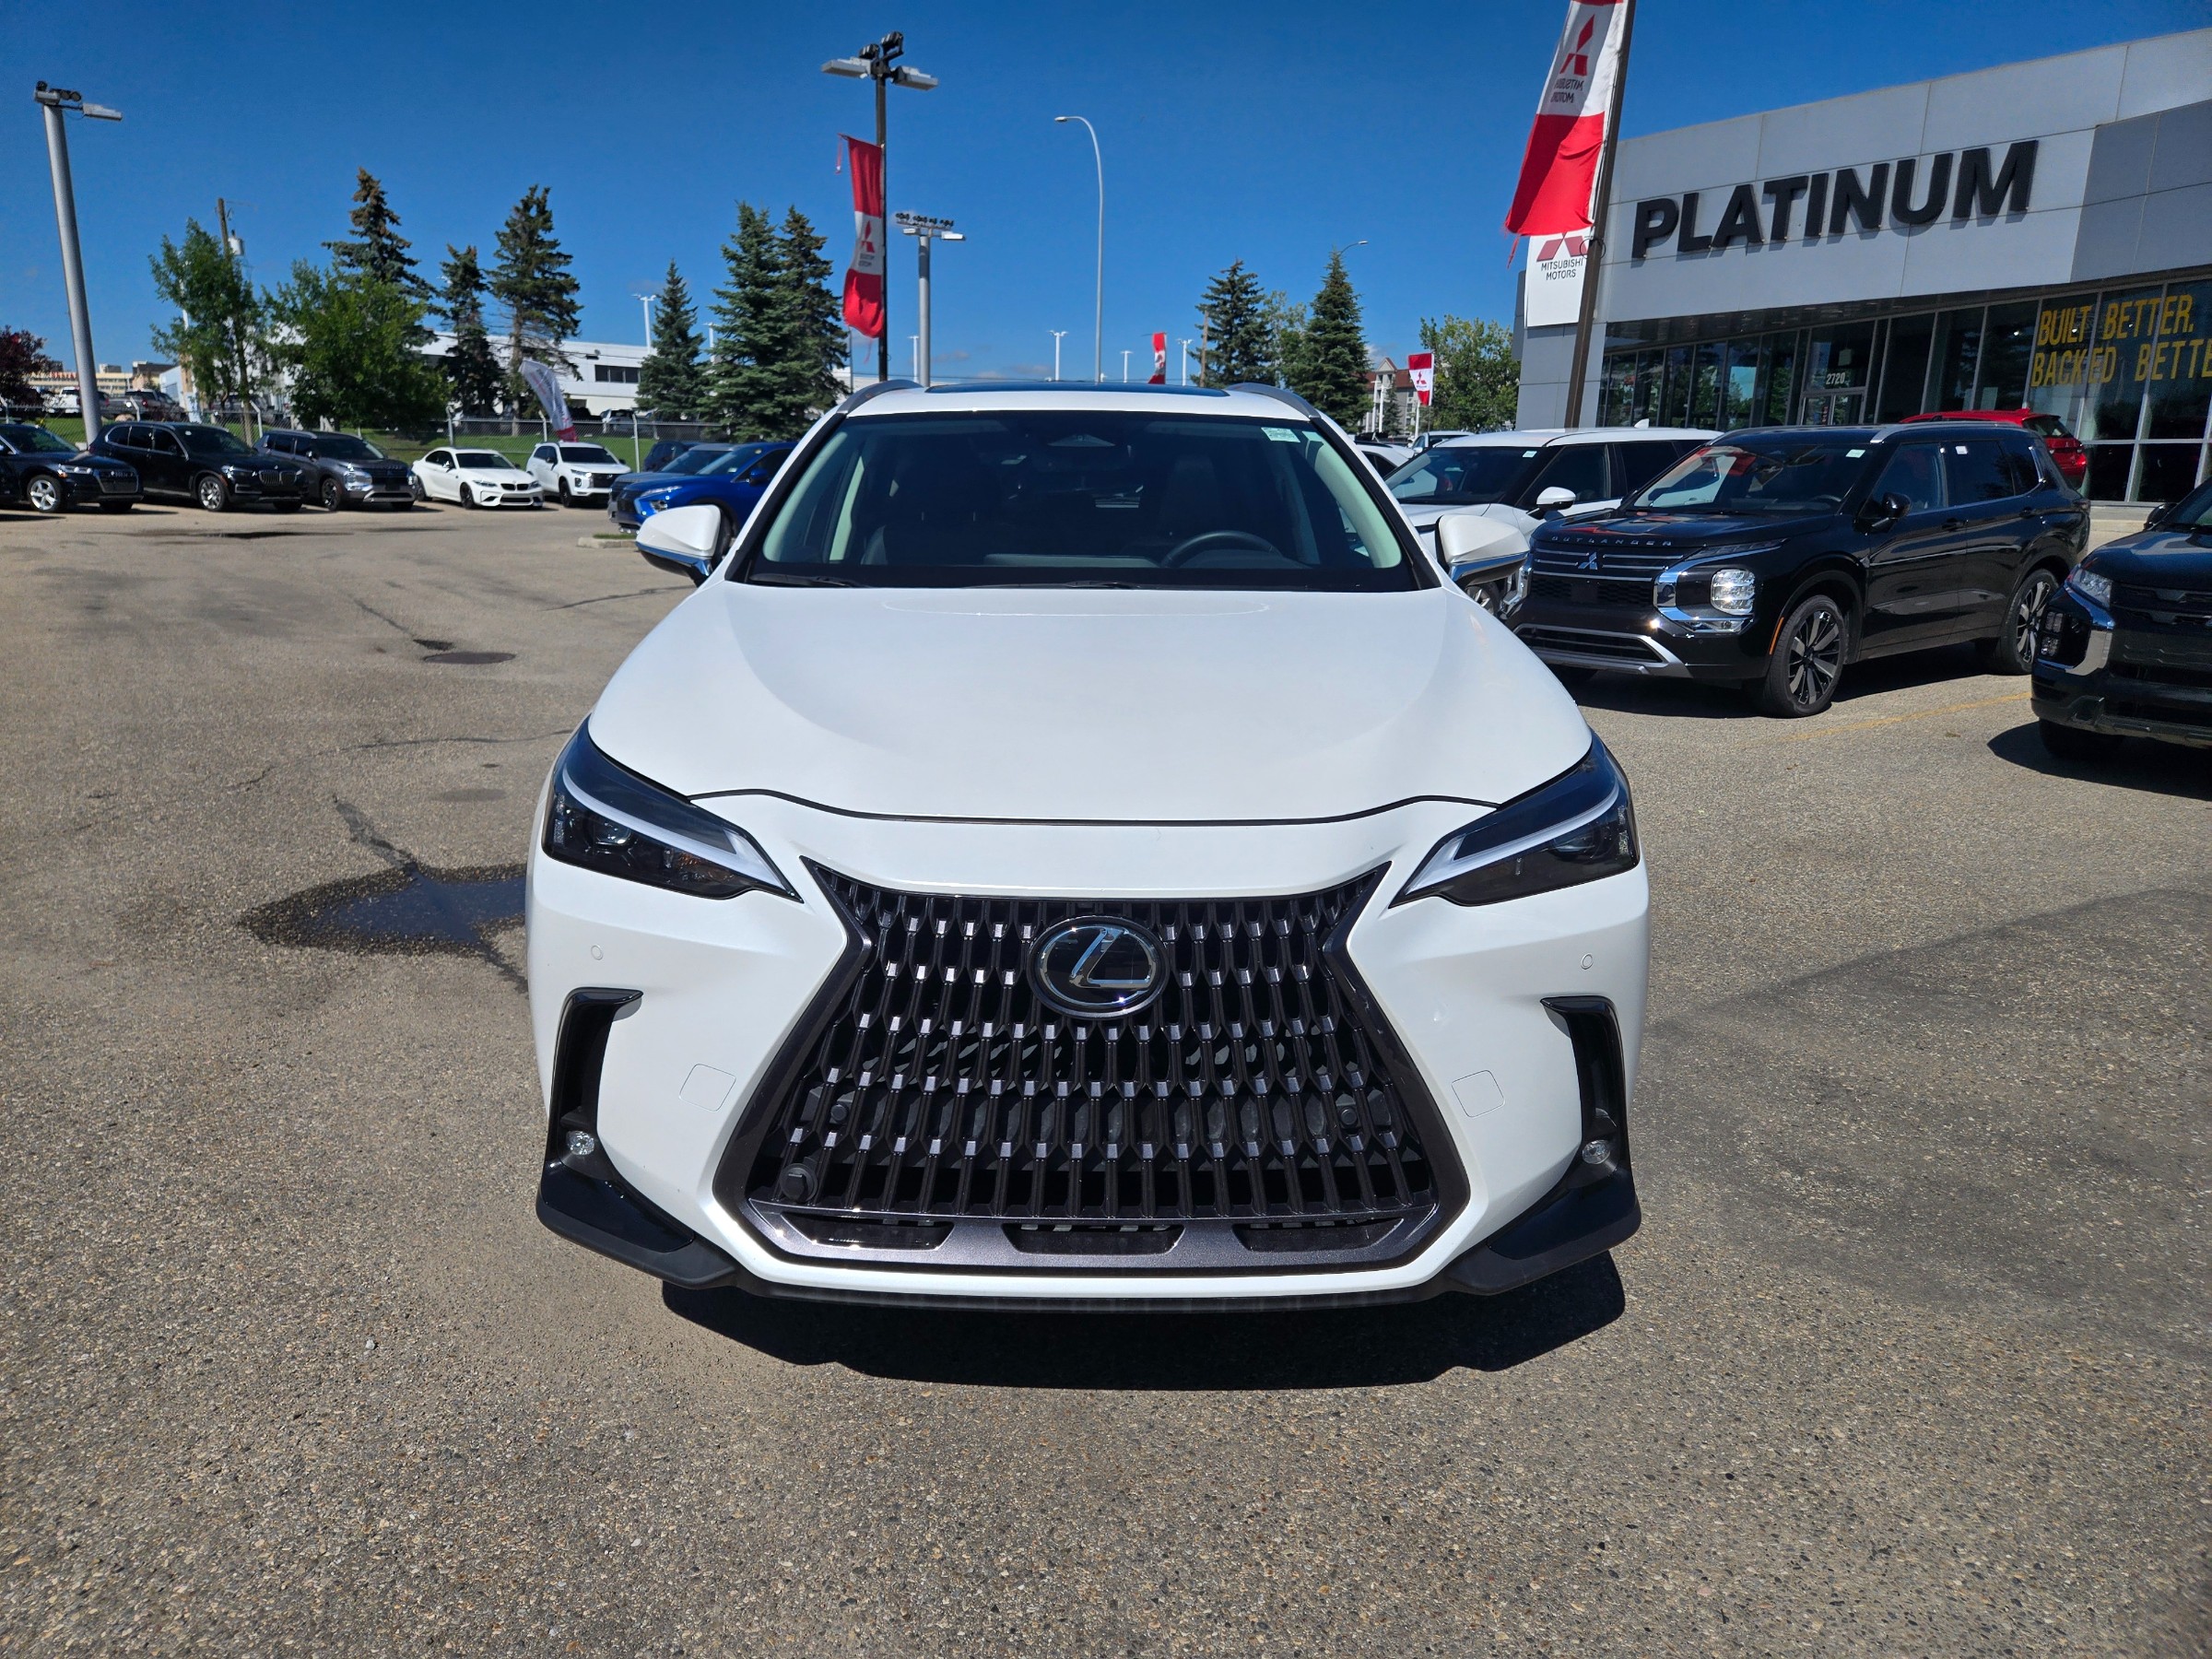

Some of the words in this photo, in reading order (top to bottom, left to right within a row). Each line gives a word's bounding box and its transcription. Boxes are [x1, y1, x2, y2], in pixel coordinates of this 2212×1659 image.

[1630, 139, 2039, 259] PLATINUM
[1541, 258, 1583, 271] MITSUBISHI
[1546, 269, 1576, 280] MOTORS
[2037, 305, 2093, 347] BUILT
[2102, 294, 2194, 340] BETTER.
[2030, 346, 2117, 387] BACKED
[1826, 372, 1846, 385] 2720
[1551, 535, 1672, 547] OUTLANDER
